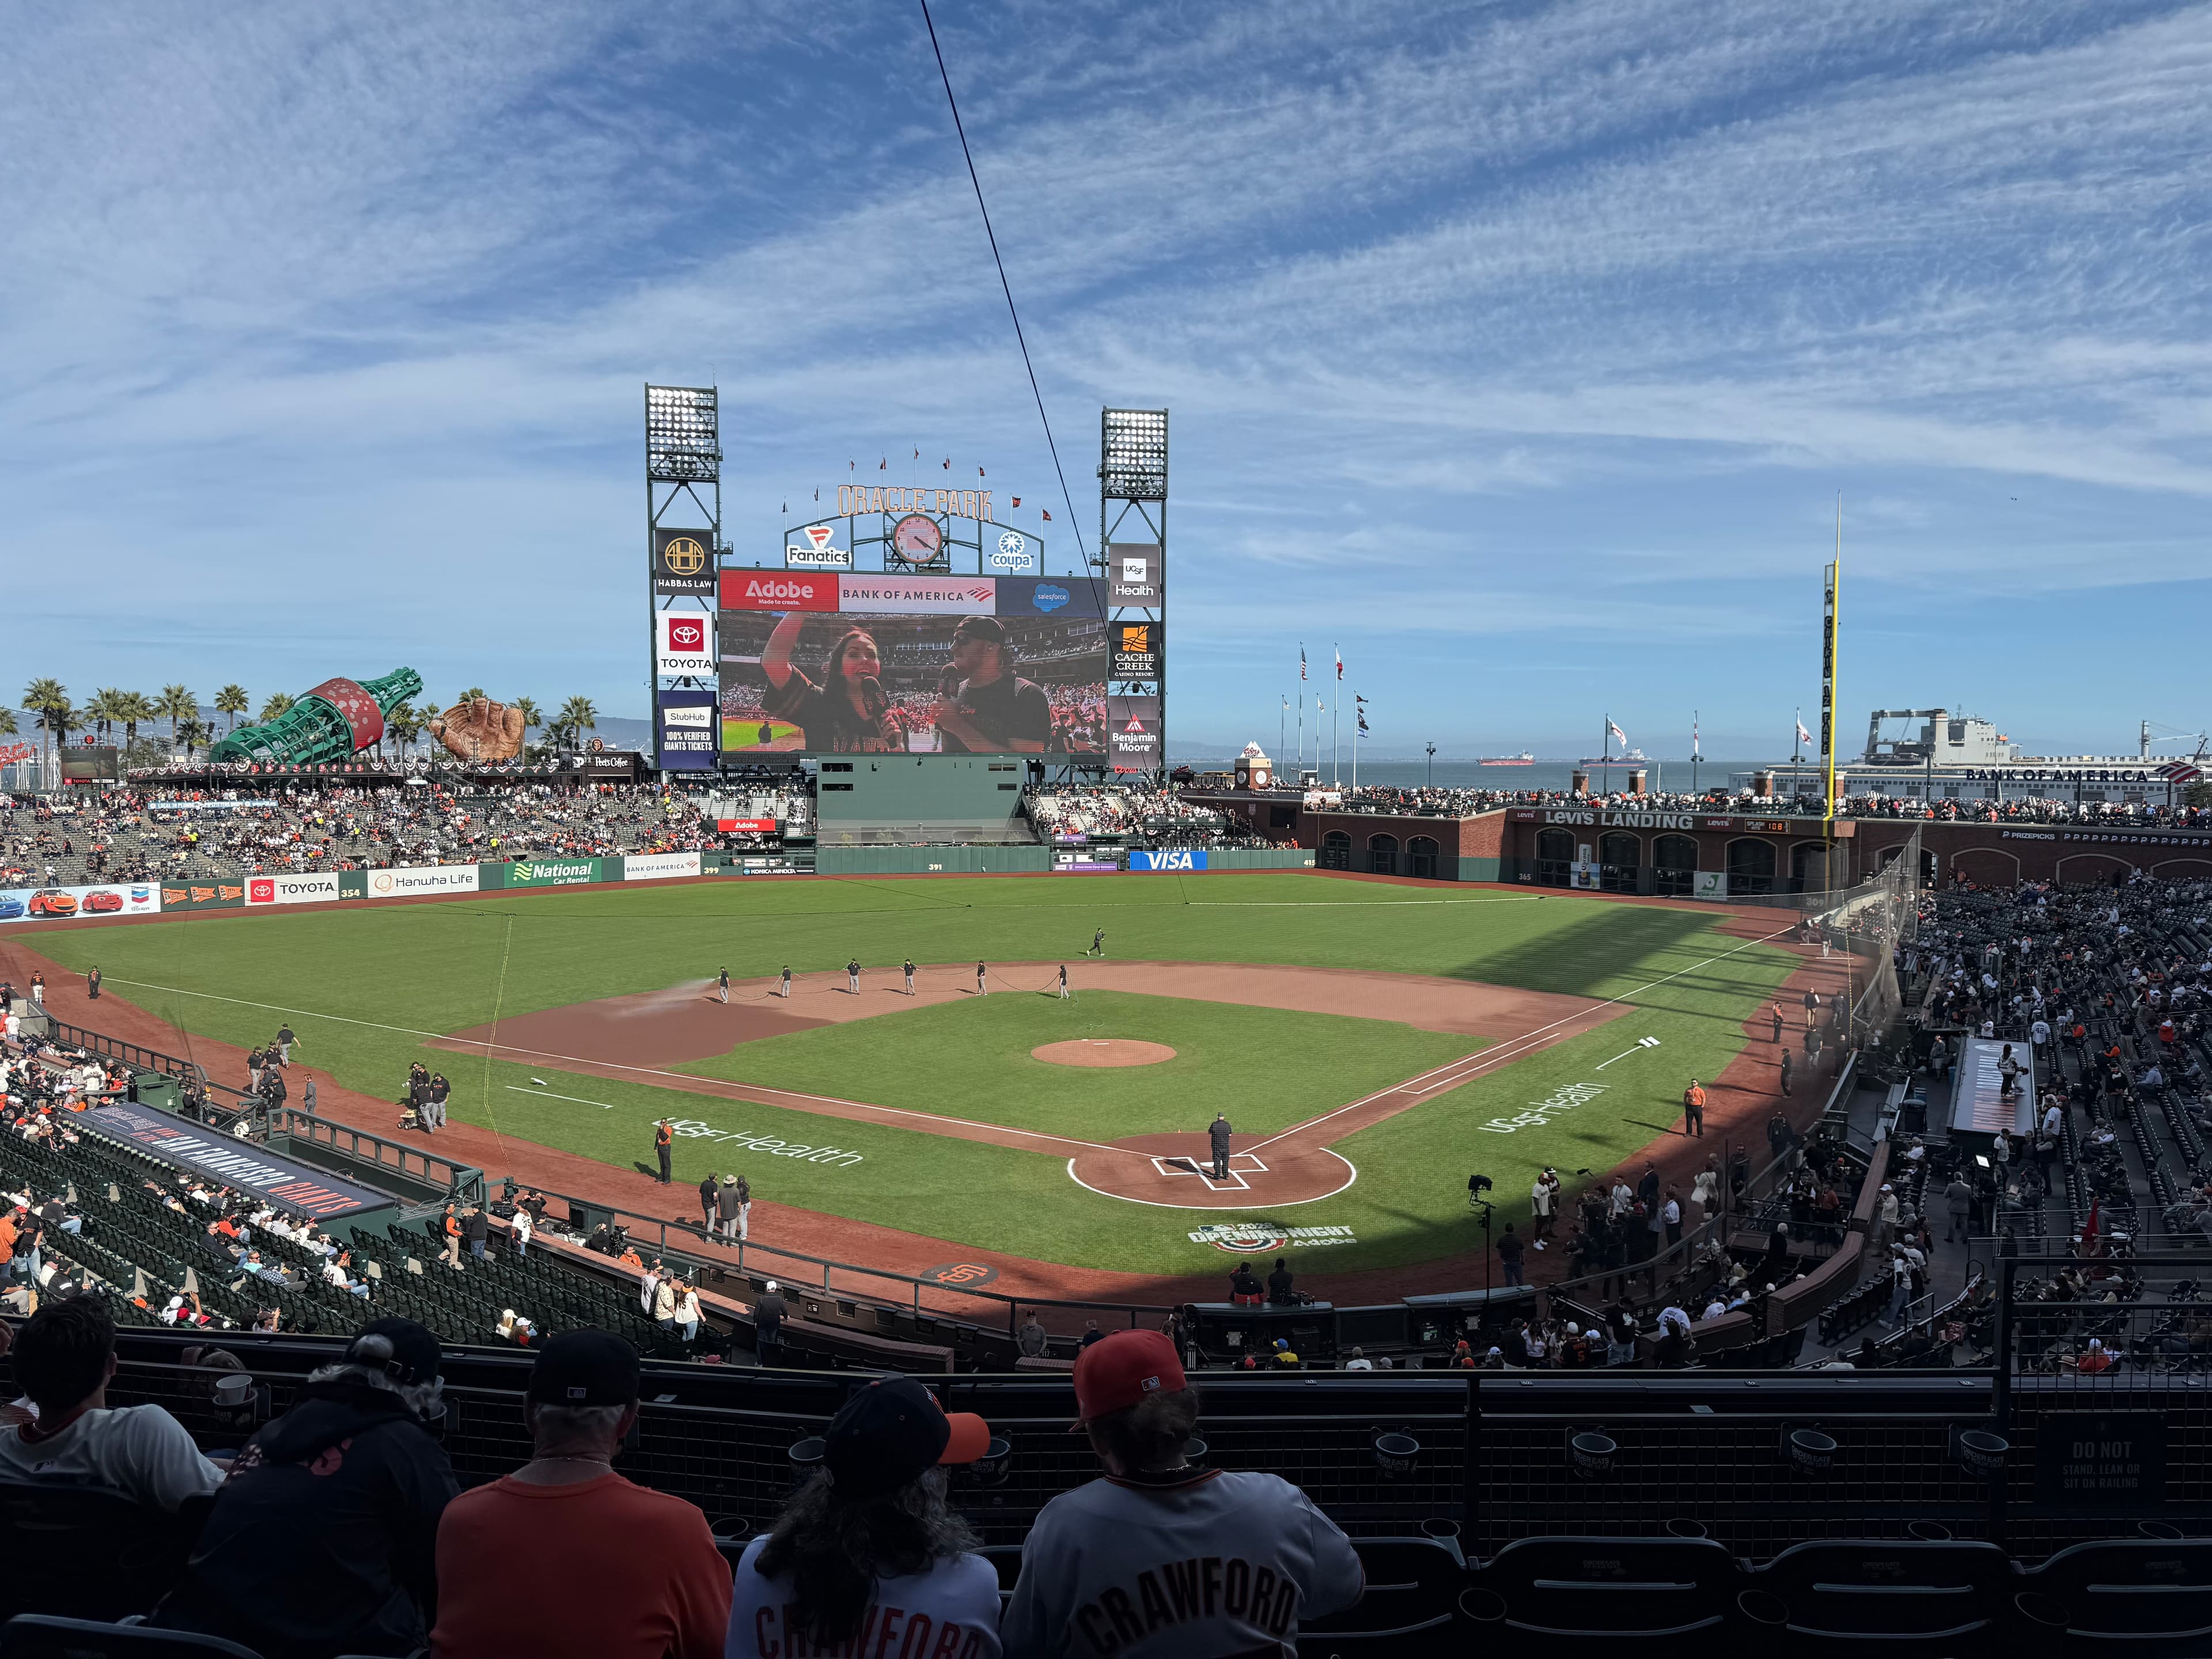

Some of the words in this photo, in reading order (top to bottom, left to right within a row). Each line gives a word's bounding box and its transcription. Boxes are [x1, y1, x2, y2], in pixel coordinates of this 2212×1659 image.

[838, 485, 925, 517] ORACLE
[935, 490, 993, 523] PARK
[790, 547, 849, 563] Fanatics
[994, 555, 1029, 568] coupa
[1125, 565, 1144, 575] UCSF
[658, 579, 692, 588] HABBAS
[694, 580, 712, 589] LAW
[745, 581, 813, 599] Adobe
[1116, 585, 1154, 596] Health
[843, 589, 880, 599] BANK
[884, 590, 900, 599] OF
[904, 591, 964, 601] AMERICA
[661, 659, 713, 669] TOYOTA
[666, 732, 683, 741] 100%
[683, 732, 711, 741] VERIFIED
[1112, 733, 1157, 744] Benjamin
[664, 742, 687, 751] GIANTS
[687, 742, 713, 751] TICKETS
[1119, 743, 1151, 752] Moore
[594, 757, 610, 767] Peet's
[611, 757, 628, 768] Coffee
[1115, 765, 1137, 774] Coors
[1966, 770, 2017, 781] BANK
[2022, 770, 2048, 781] OF
[2053, 770, 2149, 783] AMERICA
[1601, 813, 1694, 830] LANDING
[1145, 853, 1193, 869] VISA
[533, 862, 591, 879] National
[396, 876, 446, 888] Hanwha
[450, 874, 473, 884] Life
[566, 876, 589, 884] Rental
[280, 882, 334, 894] TOYOTA
[341, 889, 360, 897] 354
[1806, 898, 1824, 907] 309
[1518, 1083, 1612, 1115] Health
[127, 1118, 162, 1131] PARK
[151, 1135, 211, 1152] SAN
[713, 1131, 863, 1167] Health
[180, 1147, 296, 1187] FRANCISCO
[267, 1182, 362, 1213] GIANTS
[523, 1219, 531, 1229] 35
[1187, 1228, 1289, 1243] OPENING
[1285, 1226, 1354, 1238] NIGHT
[1963, 1446, 1987, 1461] ORDER
[2073, 1441, 2098, 1459] DO
[2100, 1441, 2133, 1459] NOT
[2062, 1464, 2096, 1476] STAND,
[2099, 1464, 2124, 1475] LEAN
[2127, 1464, 2141, 1475] OR
[2064, 1478, 2079, 1489] SIT
[2082, 1478, 2097, 1489] ON
[2099, 1477, 2138, 1488] RAILING
[1077, 1557, 1296, 1656] CRAWFORD
